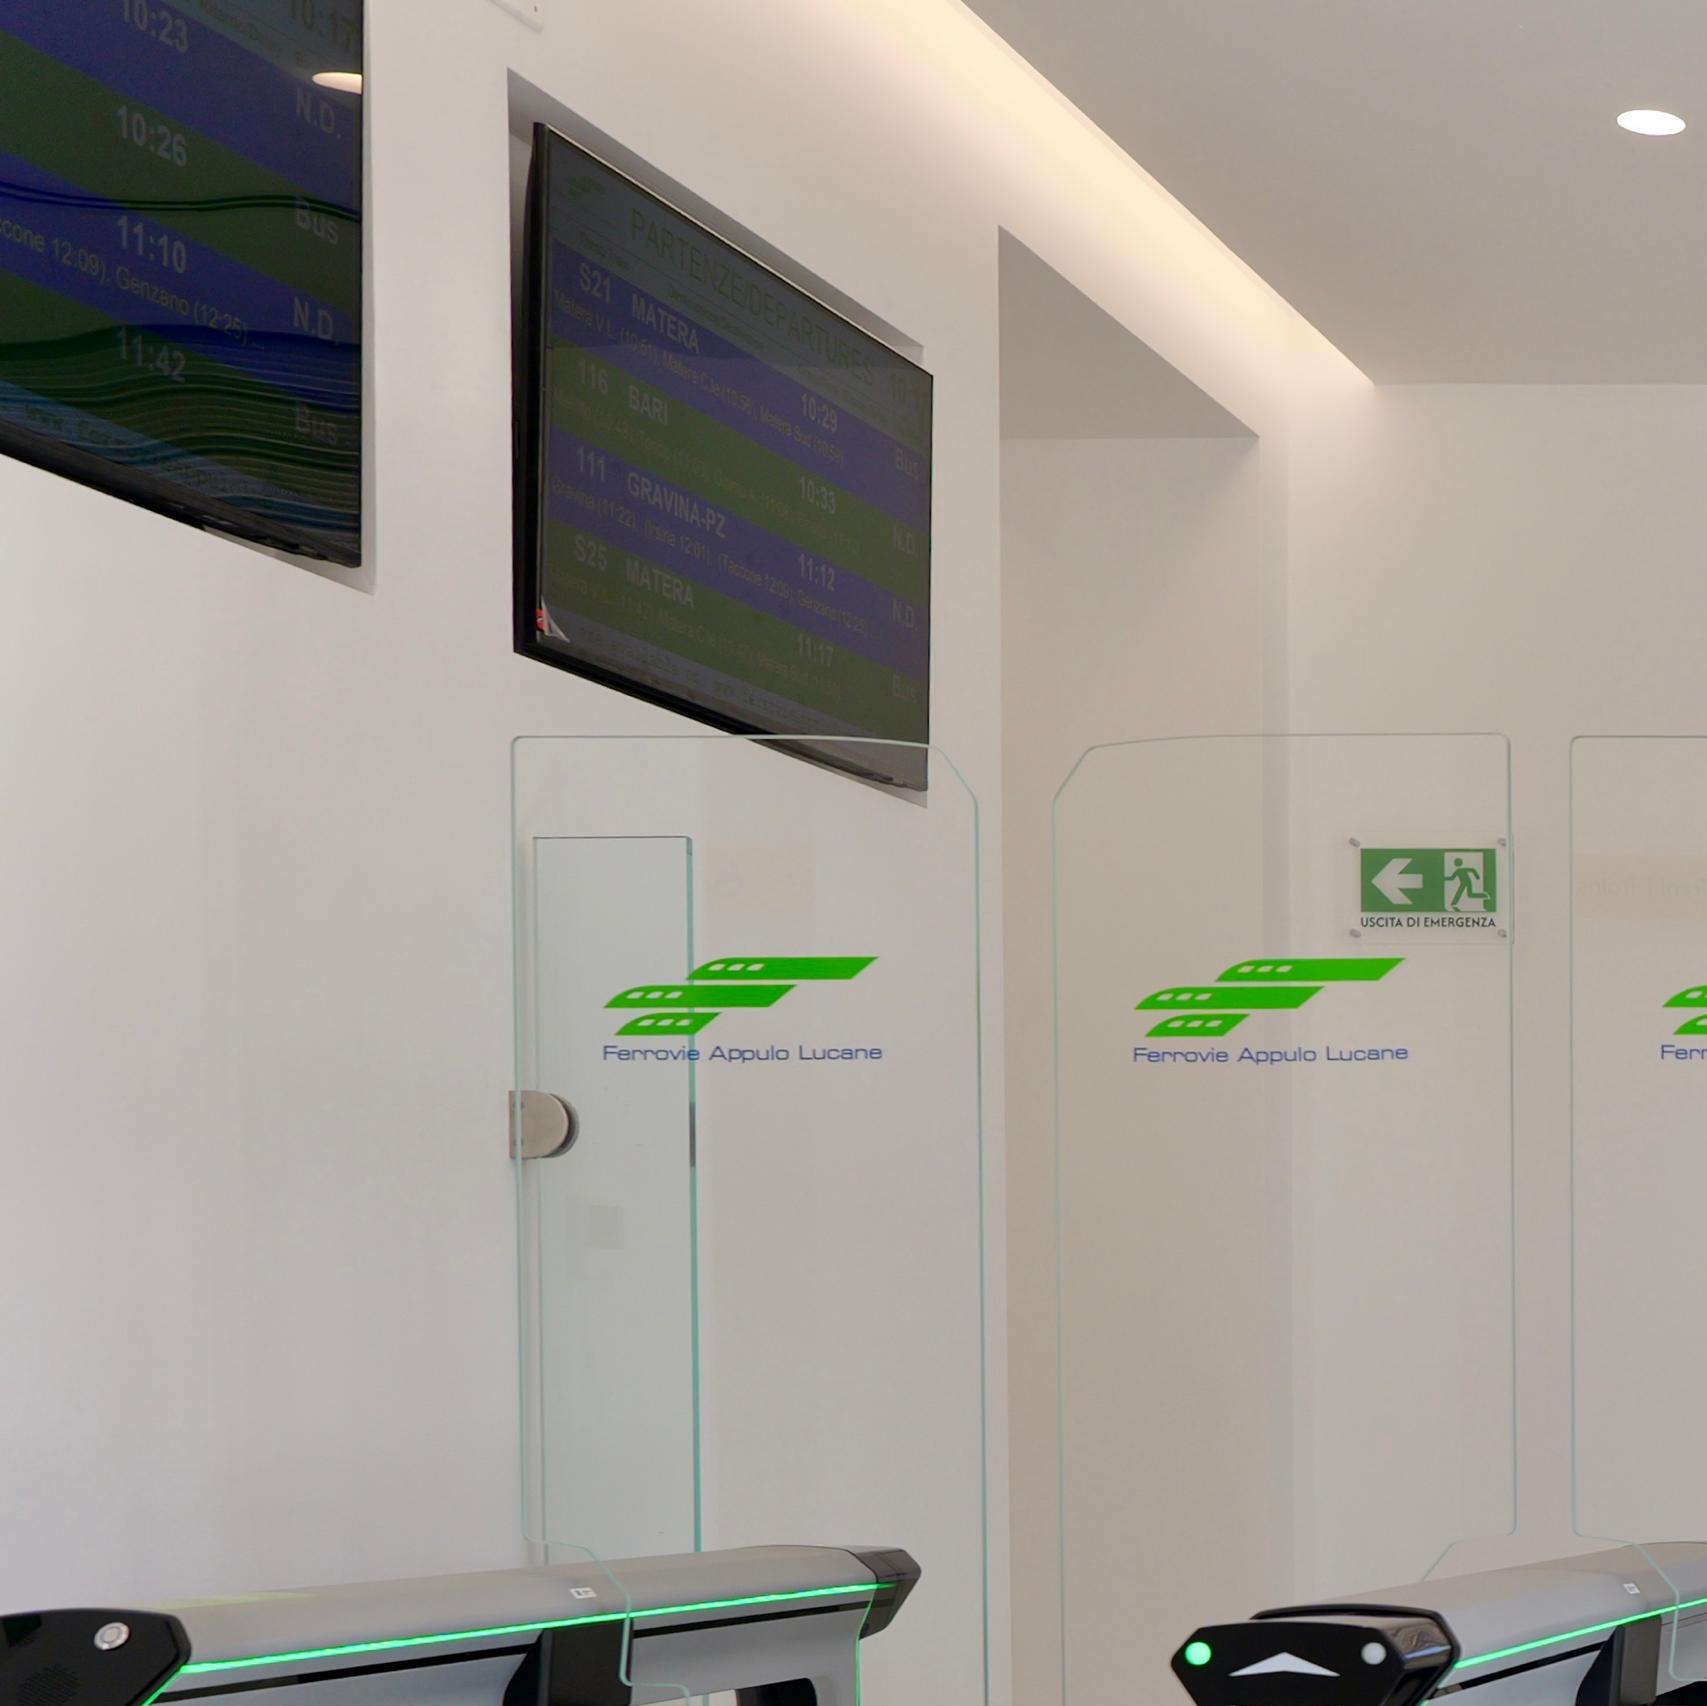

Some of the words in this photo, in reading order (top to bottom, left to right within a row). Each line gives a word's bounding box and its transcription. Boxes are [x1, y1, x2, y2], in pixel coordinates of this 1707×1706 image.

[123, 0, 189, 54] 10:23
[115, 105, 188, 168] 10:26
[116, 214, 187, 274] 11:10
[115, 265, 190, 317] Genzano
[629, 207, 875, 387] PARTENZE/DEPARTURES
[117, 329, 187, 383] 11:42
[579, 263, 612, 304] S21
[631, 293, 700, 353] MATERA
[800, 393, 838, 434] 10:29
[578, 359, 609, 397] 116
[628, 385, 669, 427] BARI
[577, 445, 607, 484] 111
[627, 471, 727, 539] GRAVINA-PZ
[798, 553, 836, 592] 11:12
[626, 557, 695, 609] MATERA
[1361, 917, 1403, 928] USCITA
[1407, 917, 1420, 928] DI
[1424, 917, 1496, 928] EMERGENZA
[603, 1045, 700, 1061] Ferrovie
[708, 1044, 790, 1064] Appulo
[798, 1045, 882, 1060] Lucane
[1133, 1047, 1229, 1063] Ferrovie
[1237, 1047, 1317, 1065] Appulo
[1326, 1045, 1409, 1061] Lucane
